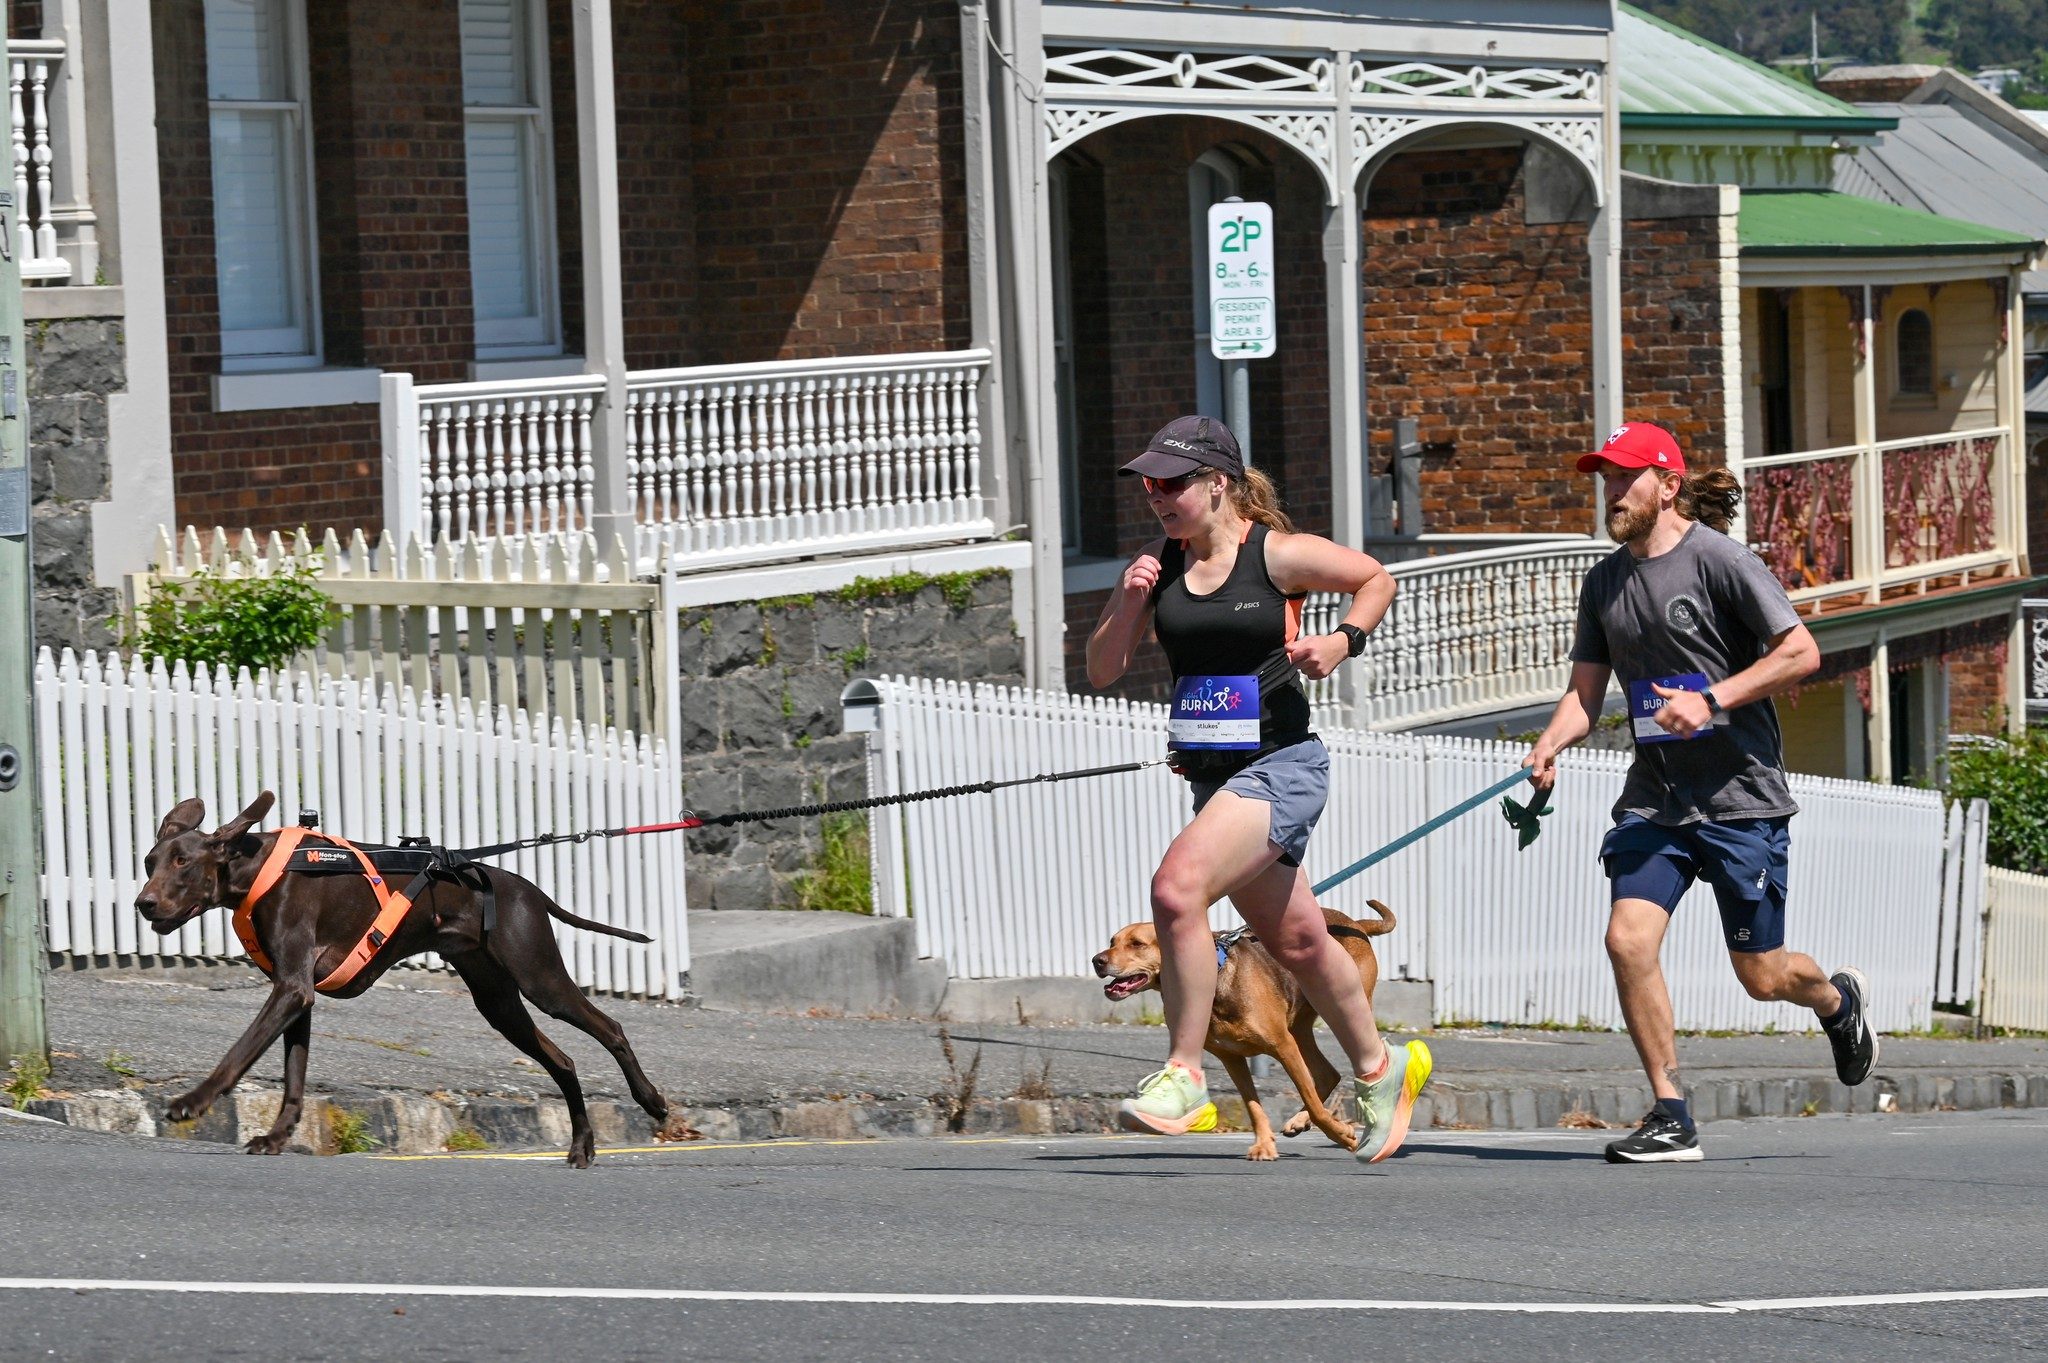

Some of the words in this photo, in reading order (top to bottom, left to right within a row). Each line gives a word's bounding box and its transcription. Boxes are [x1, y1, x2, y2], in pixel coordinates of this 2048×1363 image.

[1220, 220, 1262, 252] 2P
[1222, 281, 1241, 289] MON
[1249, 280, 1264, 288] FRI
[1218, 302, 1267, 312] RESIDENT
[1224, 314, 1261, 324] PERMIT
[1223, 327, 1251, 337] AREA
[1163, 438, 1193, 451] 2XU
[1181, 699, 1213, 711] BURN
